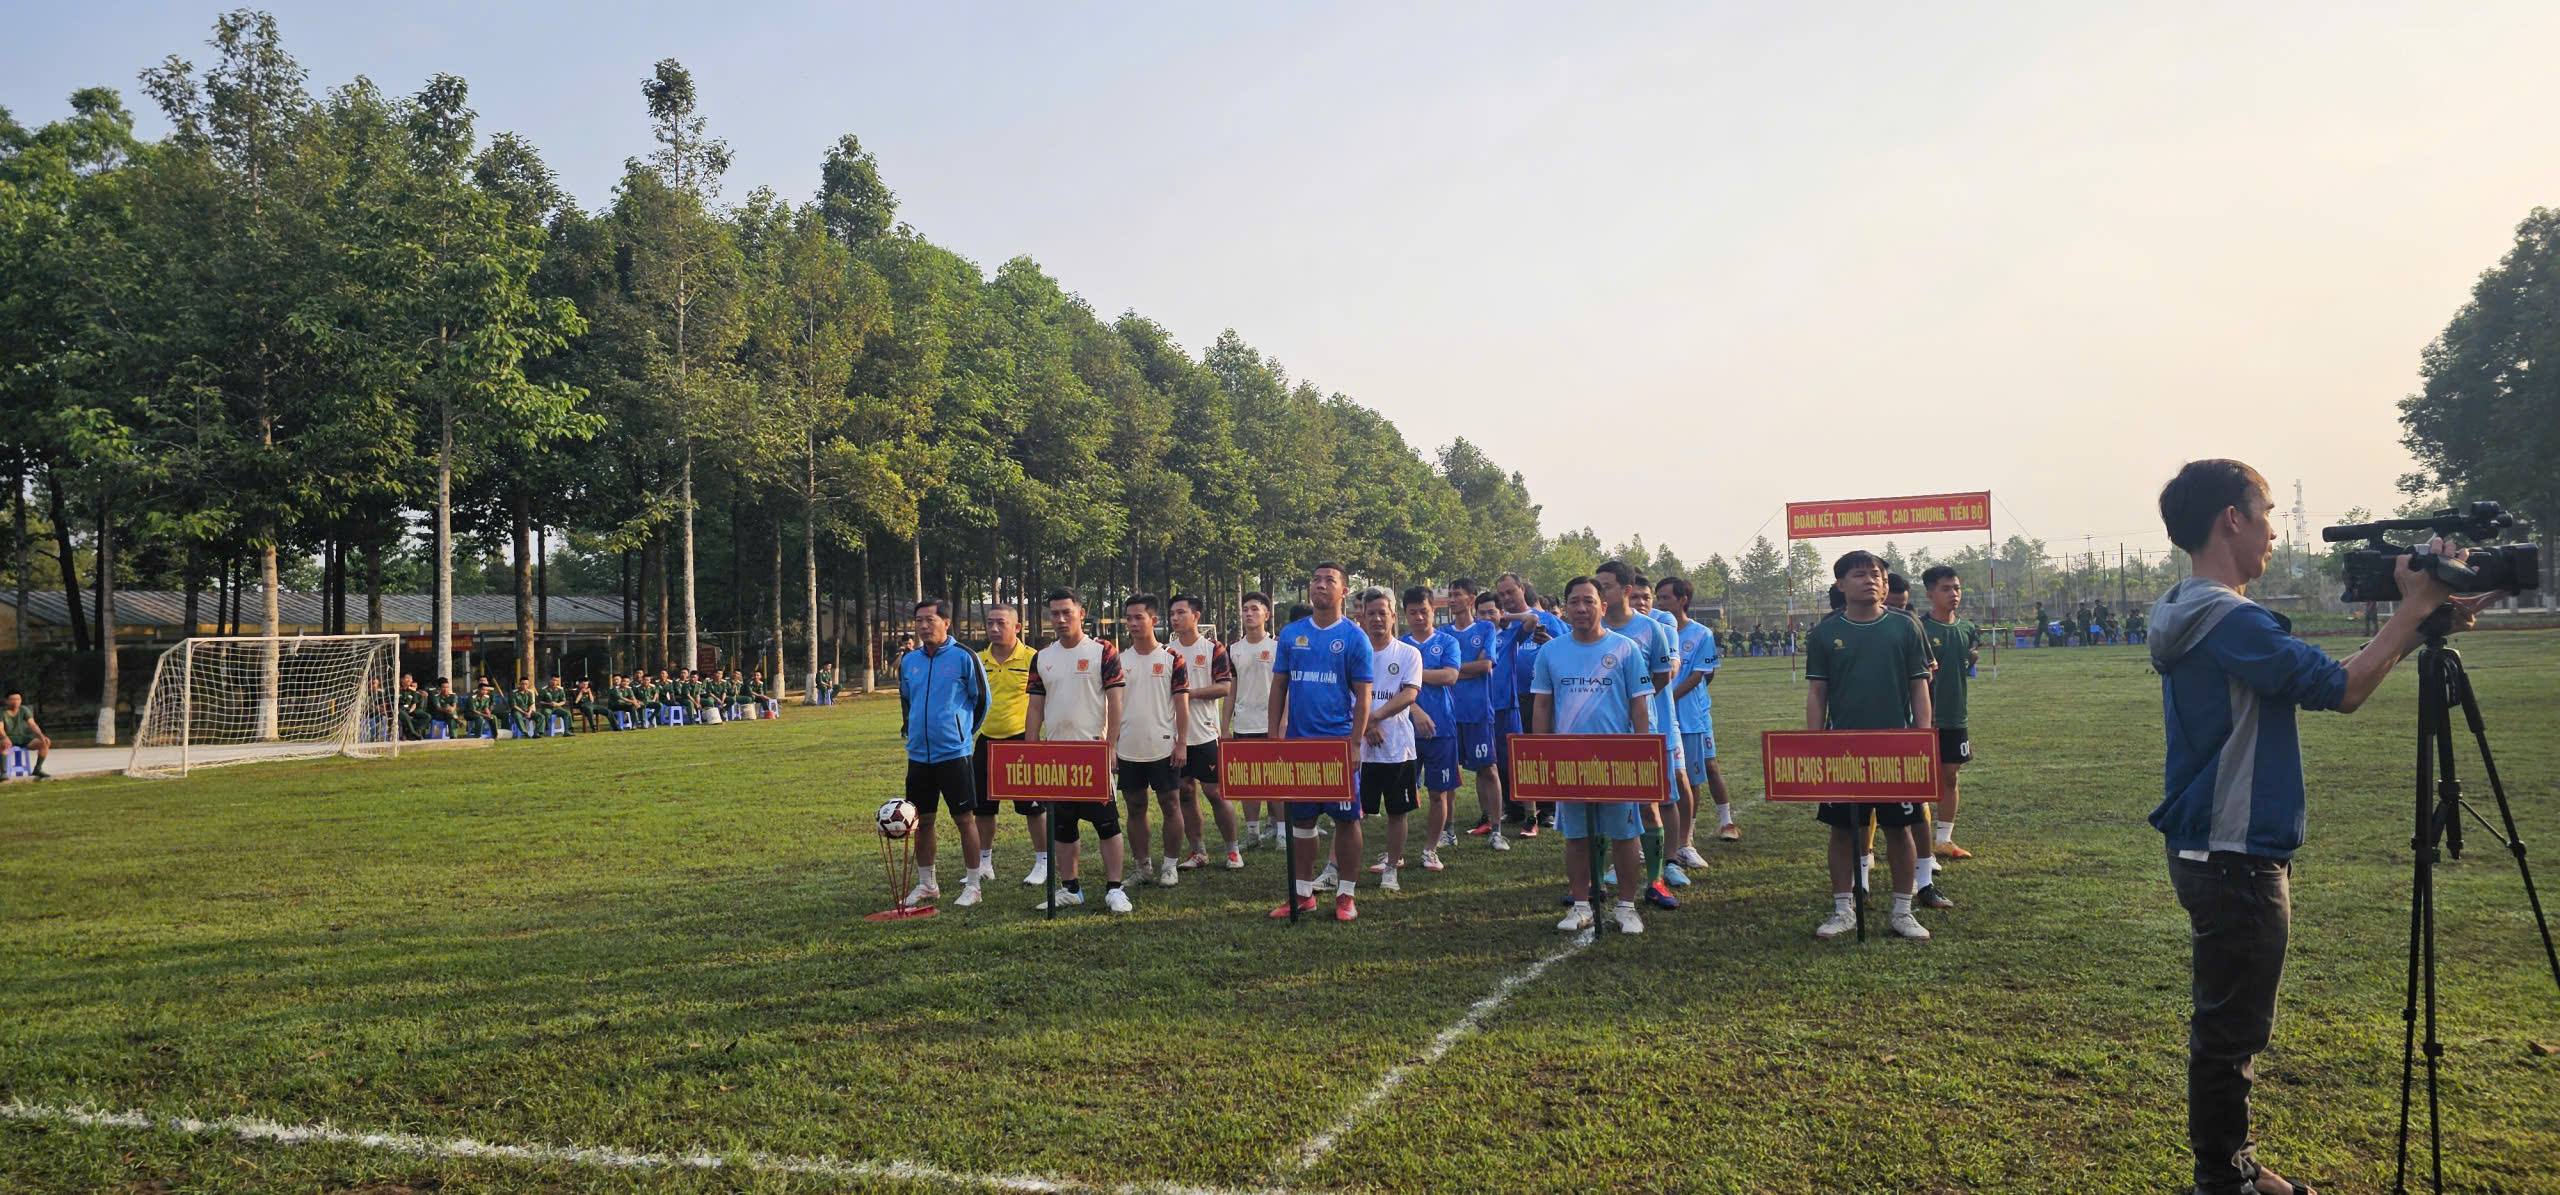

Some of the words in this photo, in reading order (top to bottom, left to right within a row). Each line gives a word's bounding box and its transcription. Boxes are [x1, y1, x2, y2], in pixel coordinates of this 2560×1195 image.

[1794, 511, 1817, 529] ĐOÀN
[1837, 511, 1864, 527] TRUNG
[1892, 509, 1909, 524] CAO
[1950, 501, 1969, 520] TIẾN
[1971, 502, 1983, 523] BỘ
[1560, 677, 1613, 686] ETIHAD
[1475, 743, 1488, 758] 69
[1006, 754, 1031, 786] TIỂU
[1034, 759, 1067, 786] ĐOÀN
[1071, 764, 1093, 787] 312
[1228, 757, 1249, 786] CÔNG
[1251, 761, 1260, 785] AN
[1263, 755, 1294, 786] PHƯỜNG
[1296, 761, 1322, 786] TRUNG
[1518, 752, 1538, 784] ĐẢNG
[1556, 760, 1577, 786] UBND
[1578, 754, 1609, 786] PHƯỜNG
[1611, 760, 1637, 786] TRUNG
[1775, 756, 1794, 783] BAN
[1798, 756, 1824, 786] CHQS
[1826, 750, 1866, 783] PHƯỜNG
[1868, 756, 1901, 783] TRUNG
